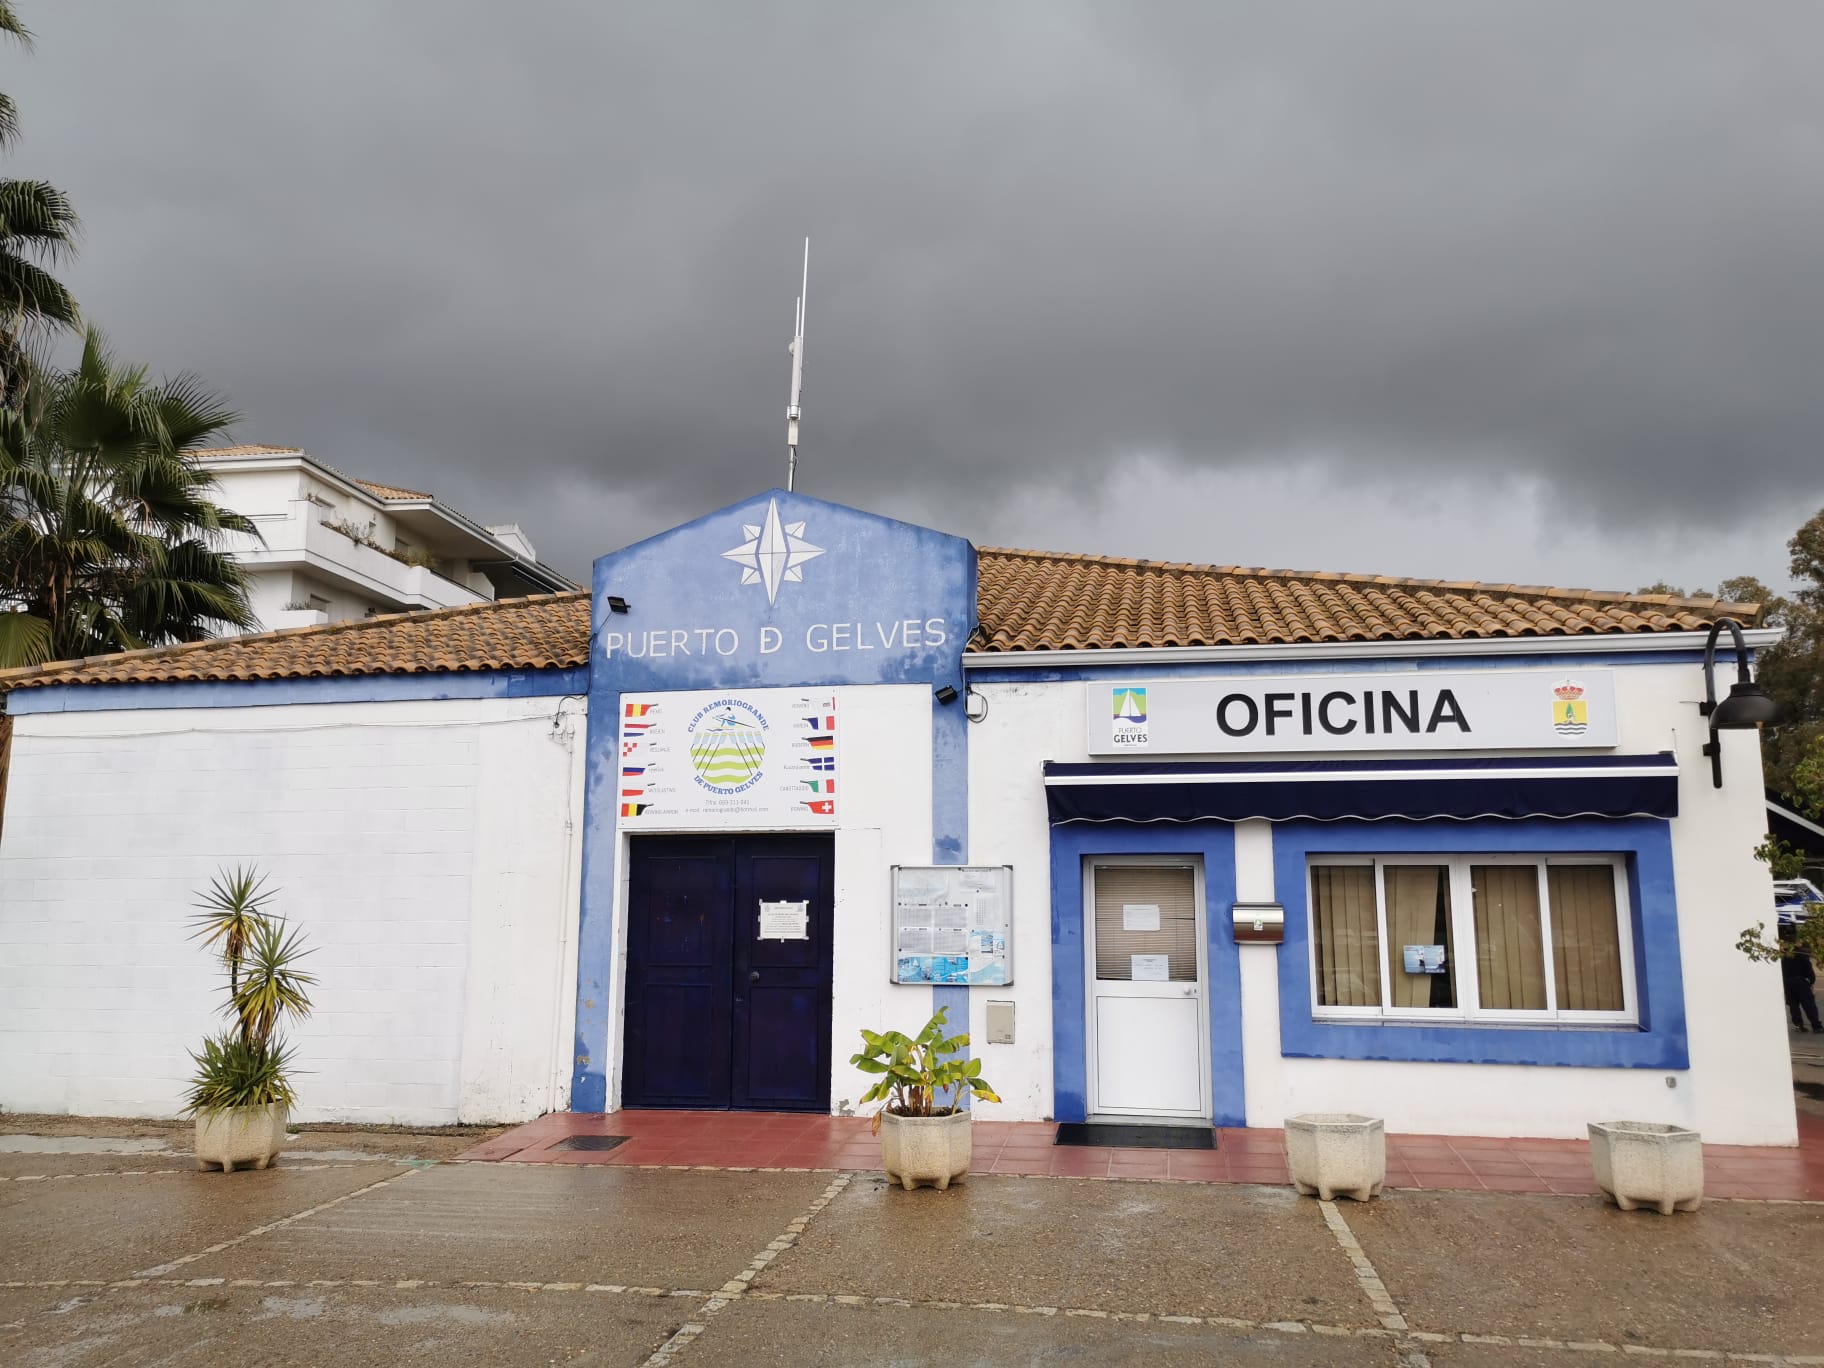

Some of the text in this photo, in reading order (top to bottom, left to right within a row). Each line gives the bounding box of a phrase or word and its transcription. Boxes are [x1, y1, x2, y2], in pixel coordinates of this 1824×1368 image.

[606, 628, 739, 659] PUERTO
[806, 618, 946, 652] GELVES
[687, 698, 771, 733] CLUB REMORIOGRANDE
[1215, 688, 1471, 738] OFICINA
[1113, 734, 1148, 743] GELVES
[693, 770, 764, 796] DE PUERTO GELVES
